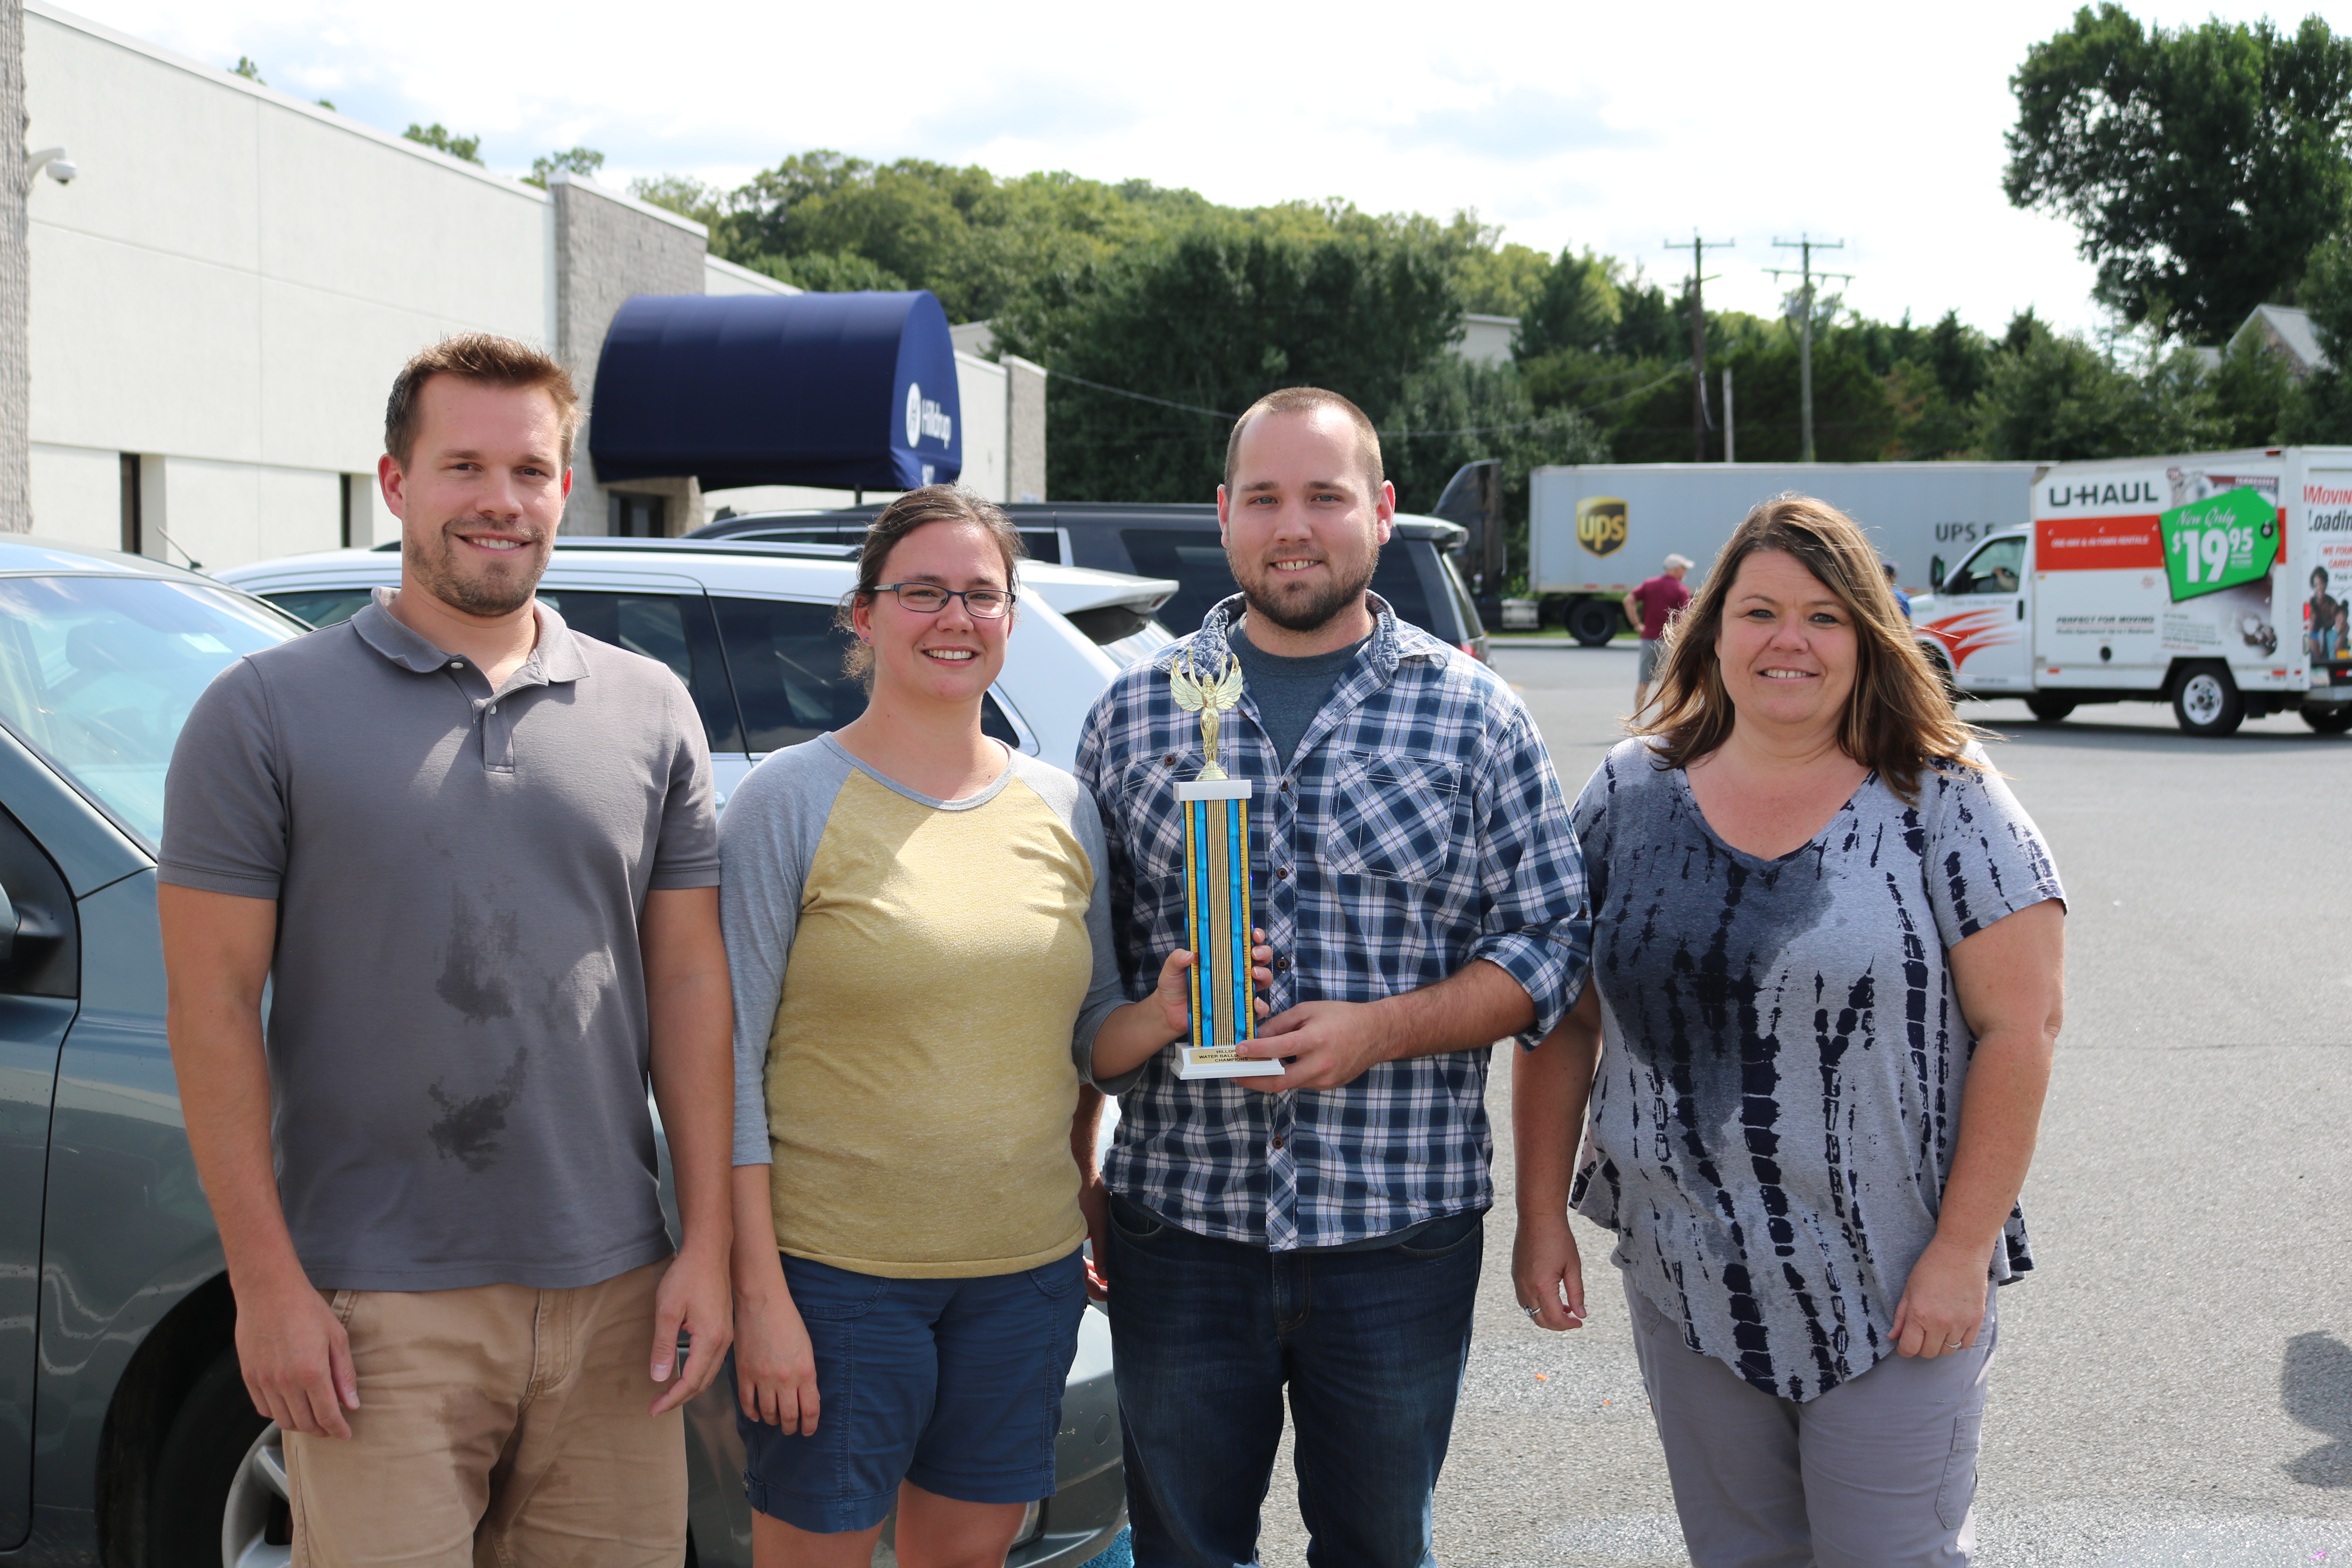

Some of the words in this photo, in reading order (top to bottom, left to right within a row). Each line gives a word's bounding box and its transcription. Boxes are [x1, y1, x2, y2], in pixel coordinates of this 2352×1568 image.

[2049, 481, 2158, 507] U-HAUL
[2176, 509, 2202, 526] Now
[2205, 506, 2237, 530] Only
[1936, 522, 1976, 543] UPS
[2117, 615, 2154, 623] MOVING
